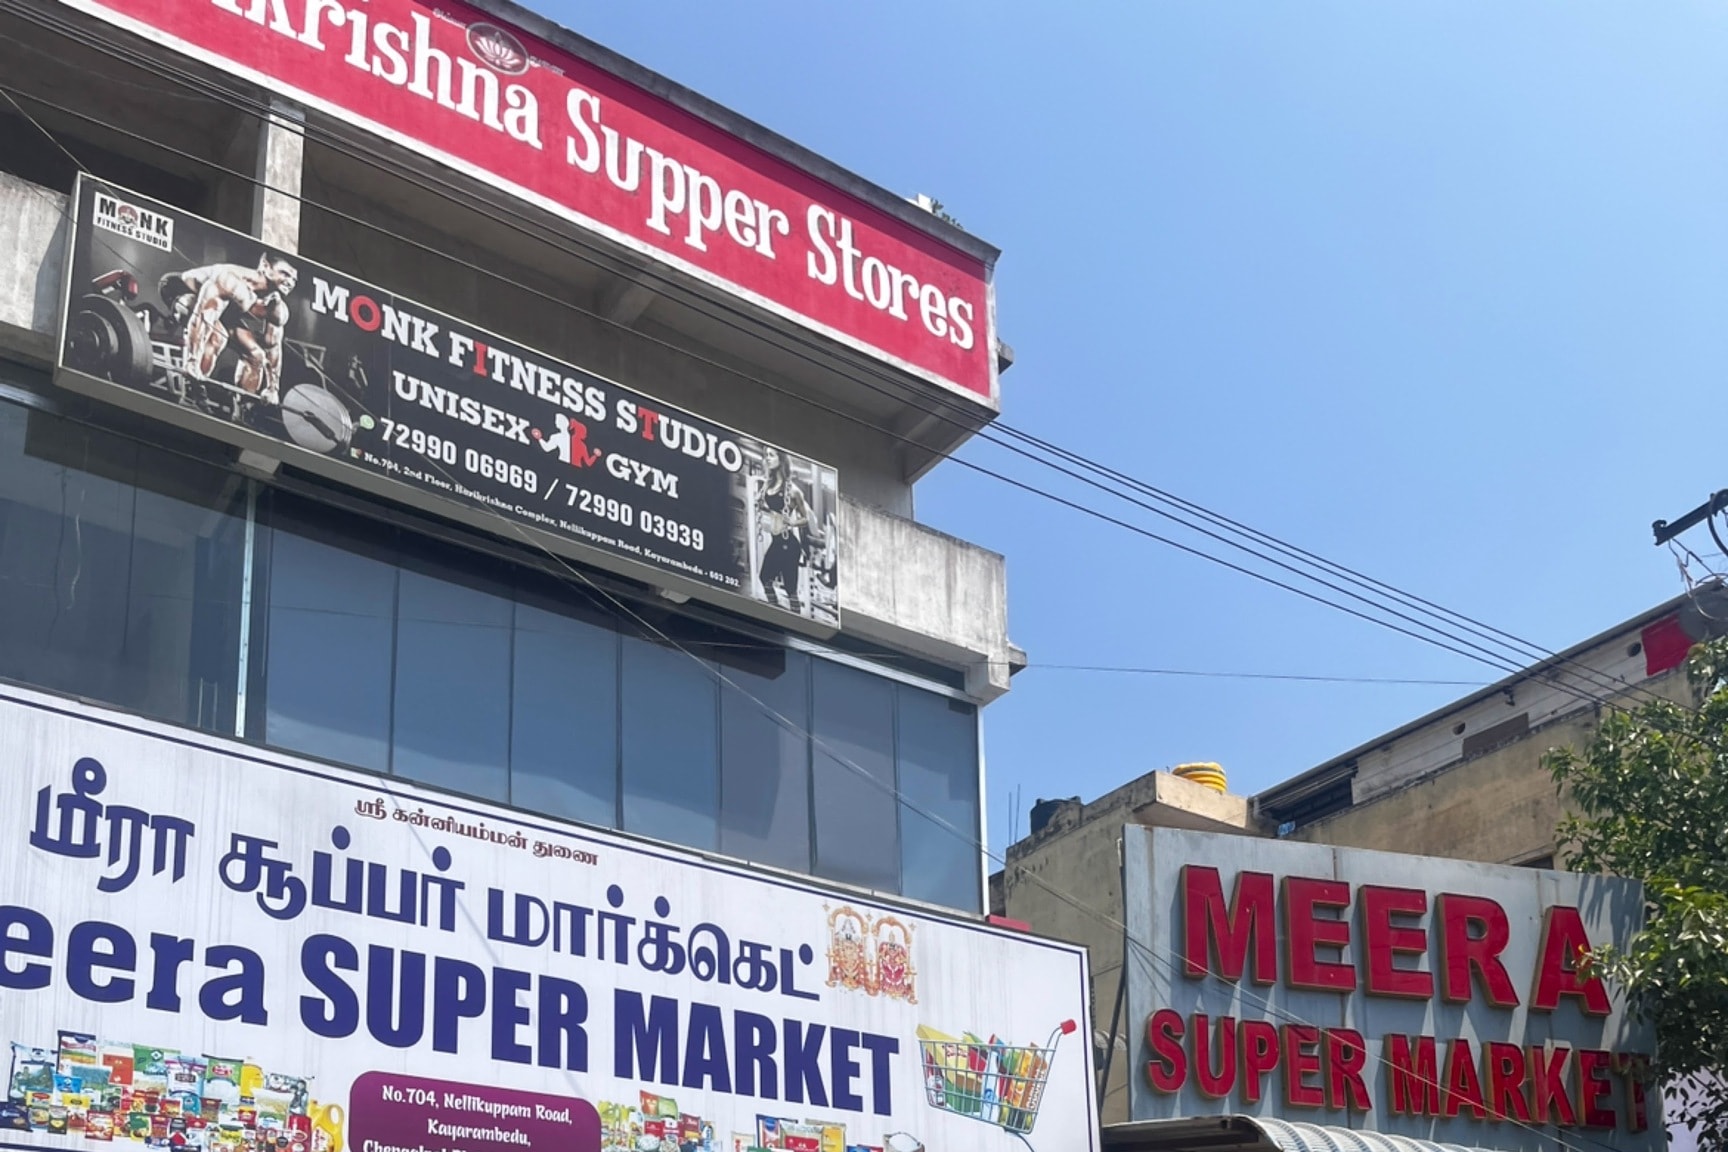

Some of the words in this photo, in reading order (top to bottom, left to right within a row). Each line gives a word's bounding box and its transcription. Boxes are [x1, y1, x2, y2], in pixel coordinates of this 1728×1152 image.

[97, 217, 133, 235] FITNESS
[136, 230, 168, 249] STUDIO
[566, 87, 789, 259] Supper
[807, 203, 974, 351] Stores
[312, 277, 440, 358] MONK
[449, 330, 607, 421] FITNESS
[617, 399, 743, 473] STUDIO
[393, 371, 532, 445] UNISEX
[606, 453, 679, 498] GYM
[380, 418, 457, 465] 72990
[465, 448, 538, 494] 06969
[544, 478, 561, 501] /
[565, 484, 633, 527] 72990
[640, 512, 705, 551] 03939
[403, 466, 423, 480] 2nd
[30, 757, 195, 893] மீரா
[219, 825, 466, 932] சூப்பர்
[487, 884, 820, 1001] மார்க்கெட்
[532, 840, 599, 867] துணை
[1181, 864, 1613, 1017] MEERA
[300, 933, 589, 1074] SUPER
[613, 987, 900, 1117] MARKET
[1147, 1008, 1372, 1112] SUPER
[1385, 1032, 1651, 1133] MARKET
[382, 1084, 439, 1109] No.704,
[444, 1093, 531, 1120] Nellikuppam
[535, 1103, 573, 1126] Road,
[427, 1118, 531, 1147] Kayarambedu,
